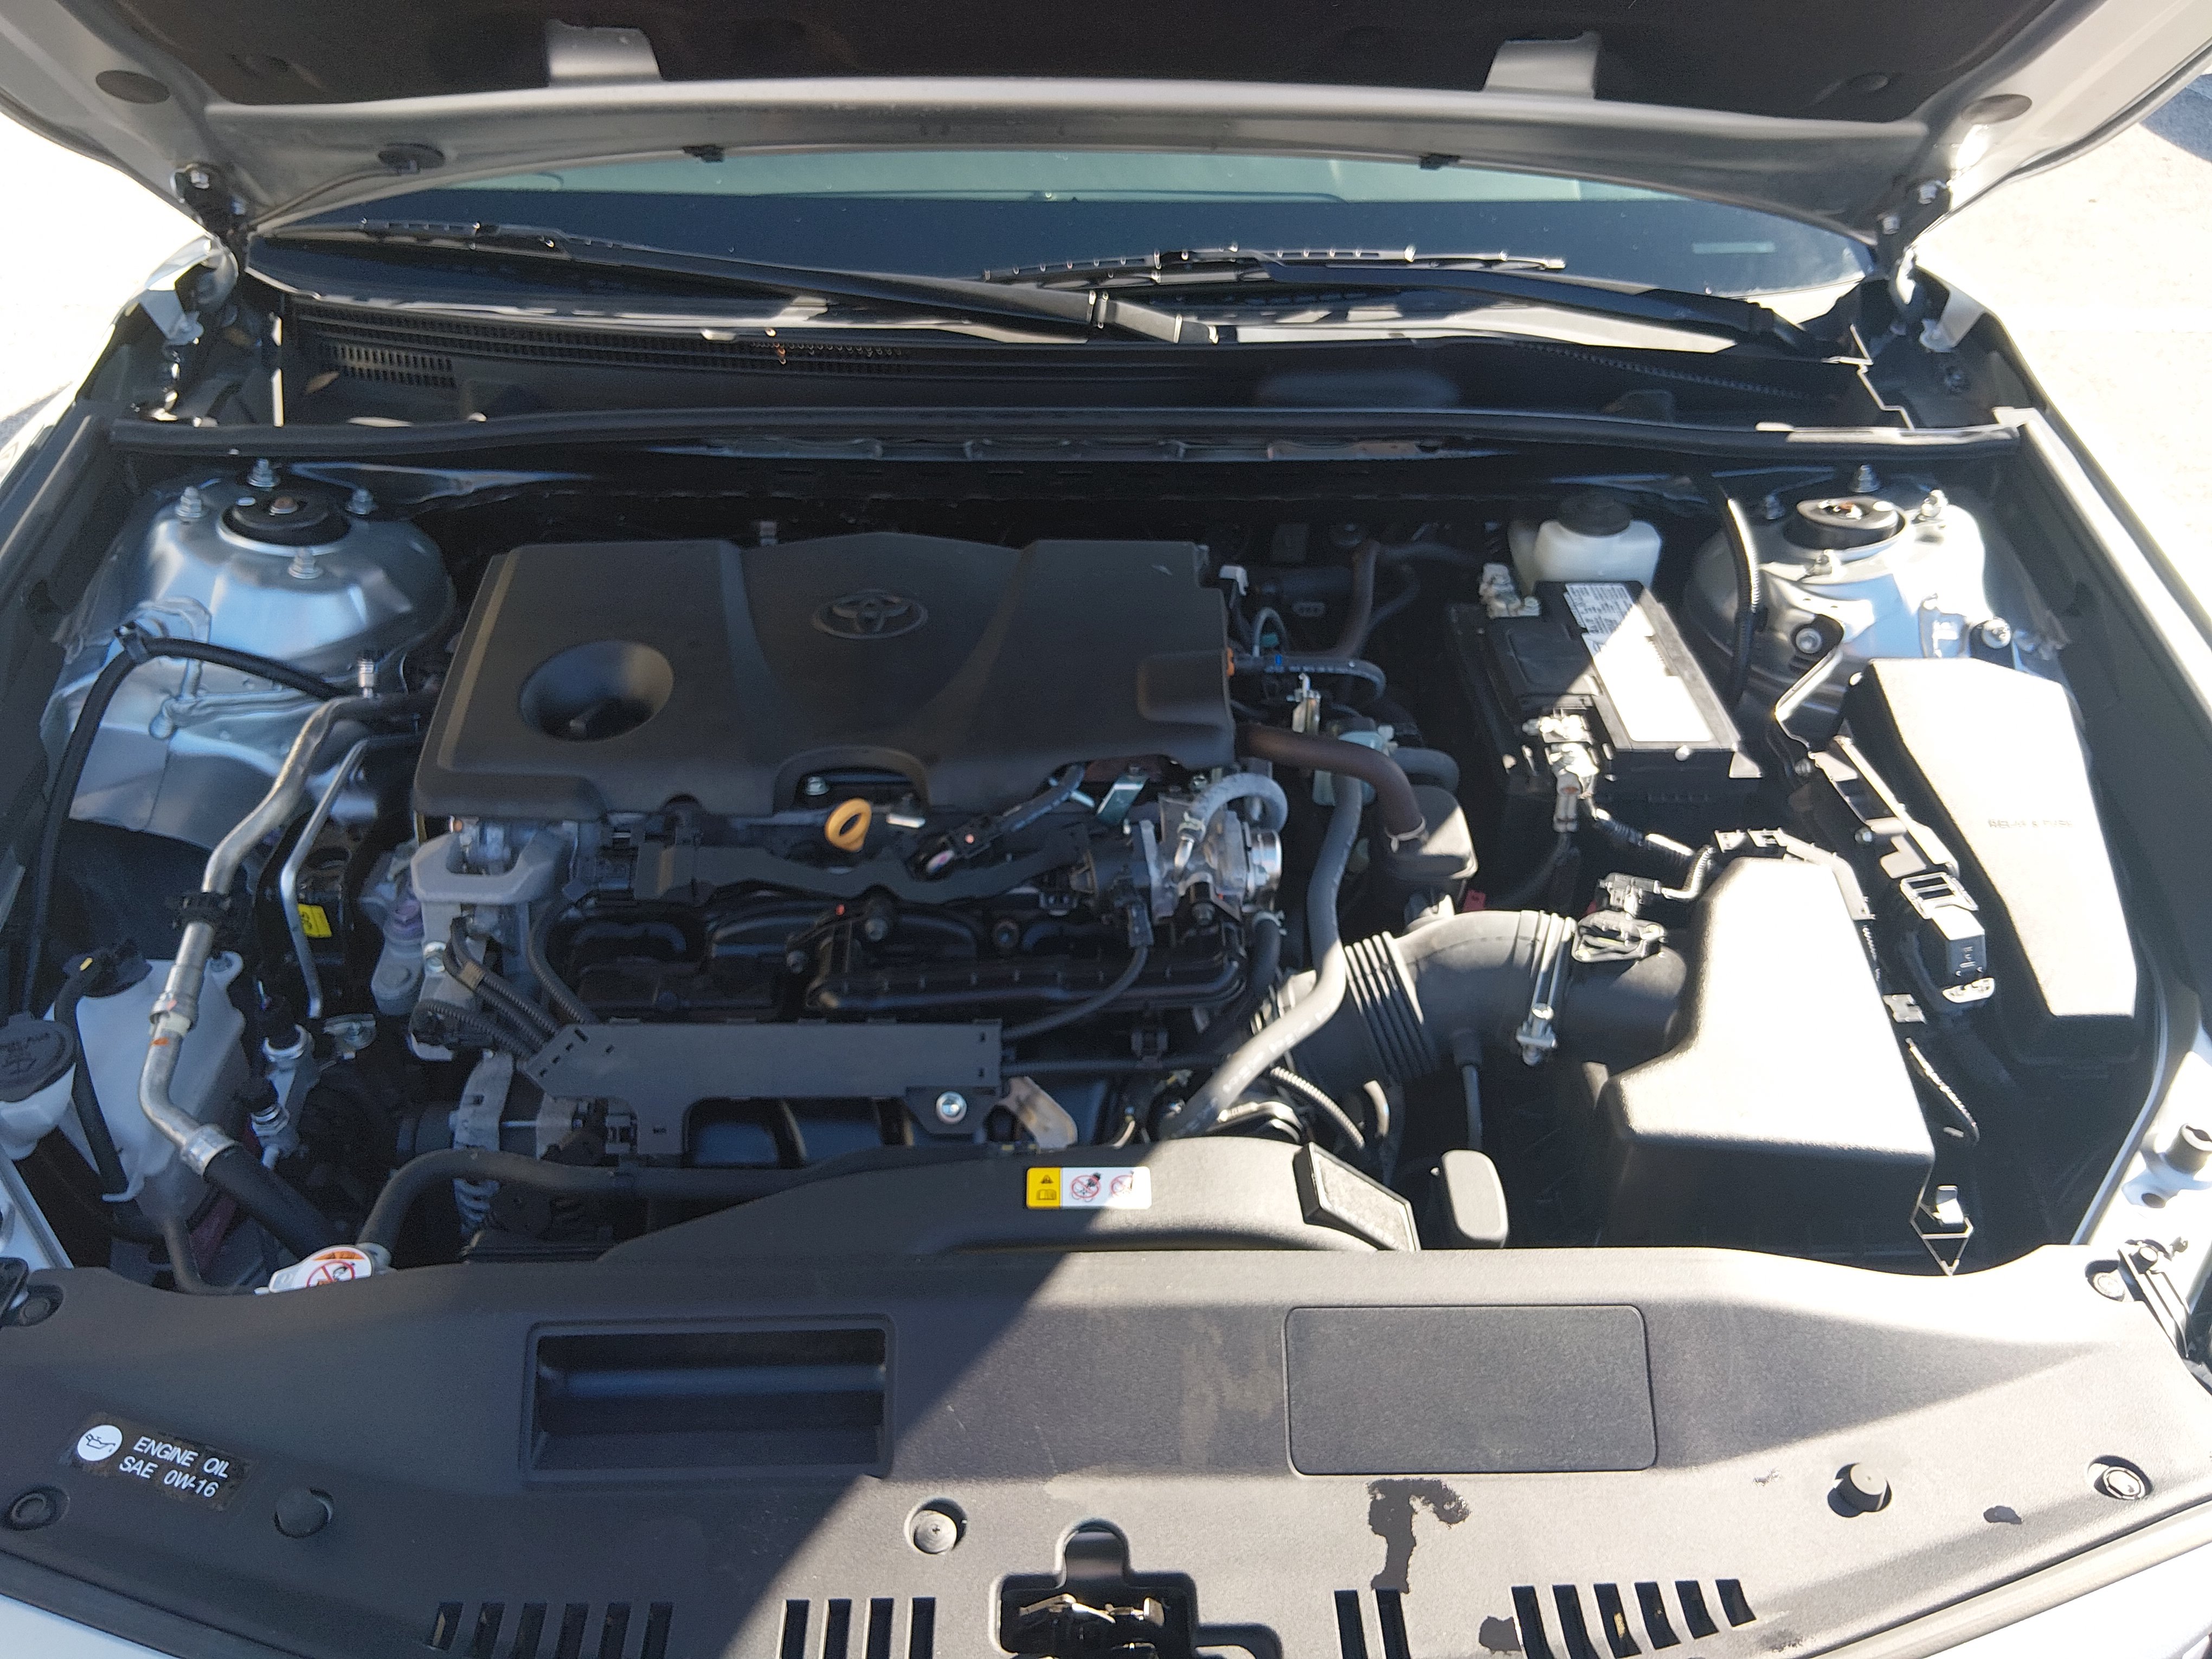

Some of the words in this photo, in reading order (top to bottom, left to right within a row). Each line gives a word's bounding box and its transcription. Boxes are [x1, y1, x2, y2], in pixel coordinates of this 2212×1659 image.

[119, 1456, 159, 1479] SAE
[163, 1469, 219, 1498] 0W-16
[133, 1436, 199, 1467] ENGINE
[202, 1457, 230, 1478] OIL
